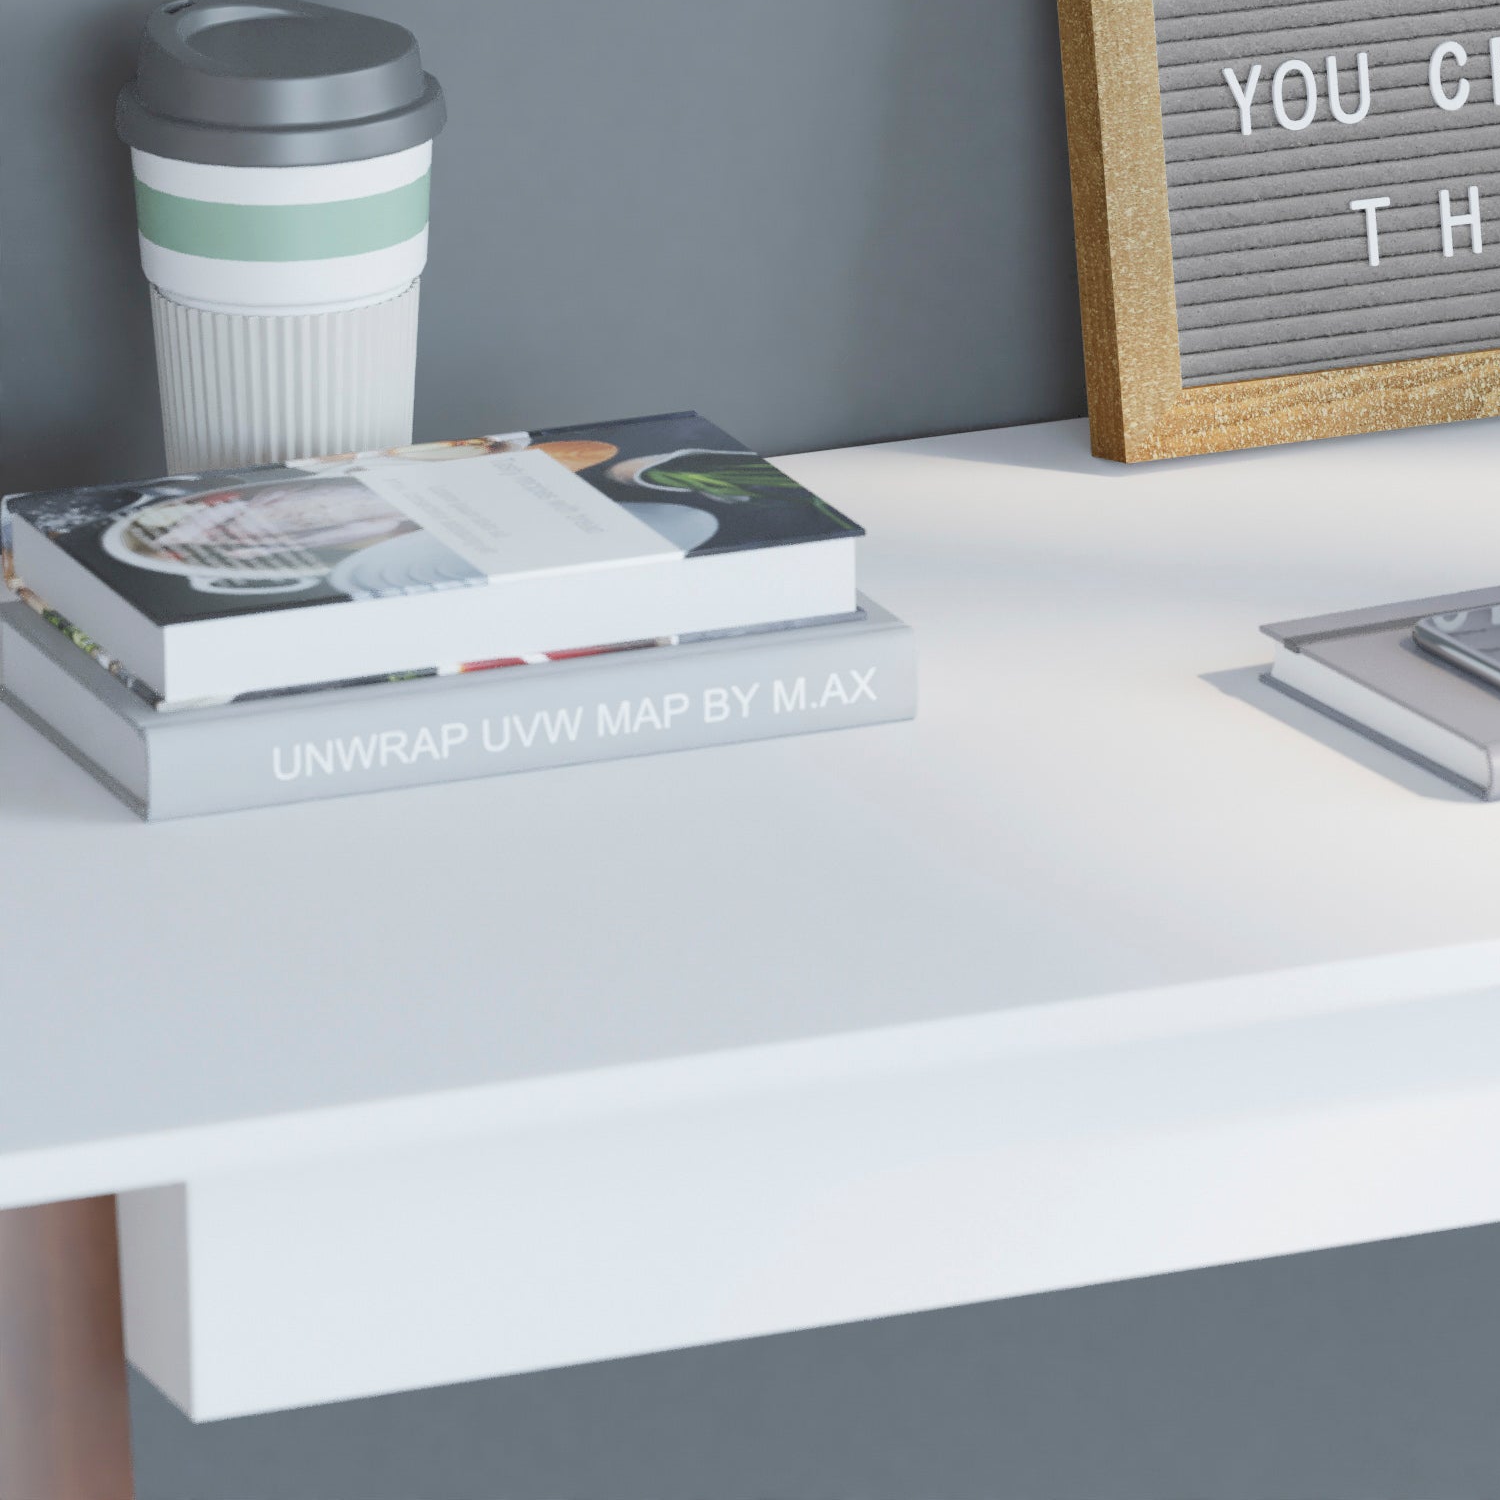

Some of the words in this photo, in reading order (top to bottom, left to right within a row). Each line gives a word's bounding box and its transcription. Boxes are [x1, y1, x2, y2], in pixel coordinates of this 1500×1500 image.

[1222, 51, 1373, 136] YOU
[272, 720, 469, 781] UNWRAP
[481, 706, 584, 753] UVW
[596, 692, 691, 737] MAP
[701, 682, 761, 724] BY
[771, 667, 878, 714] M.AX
